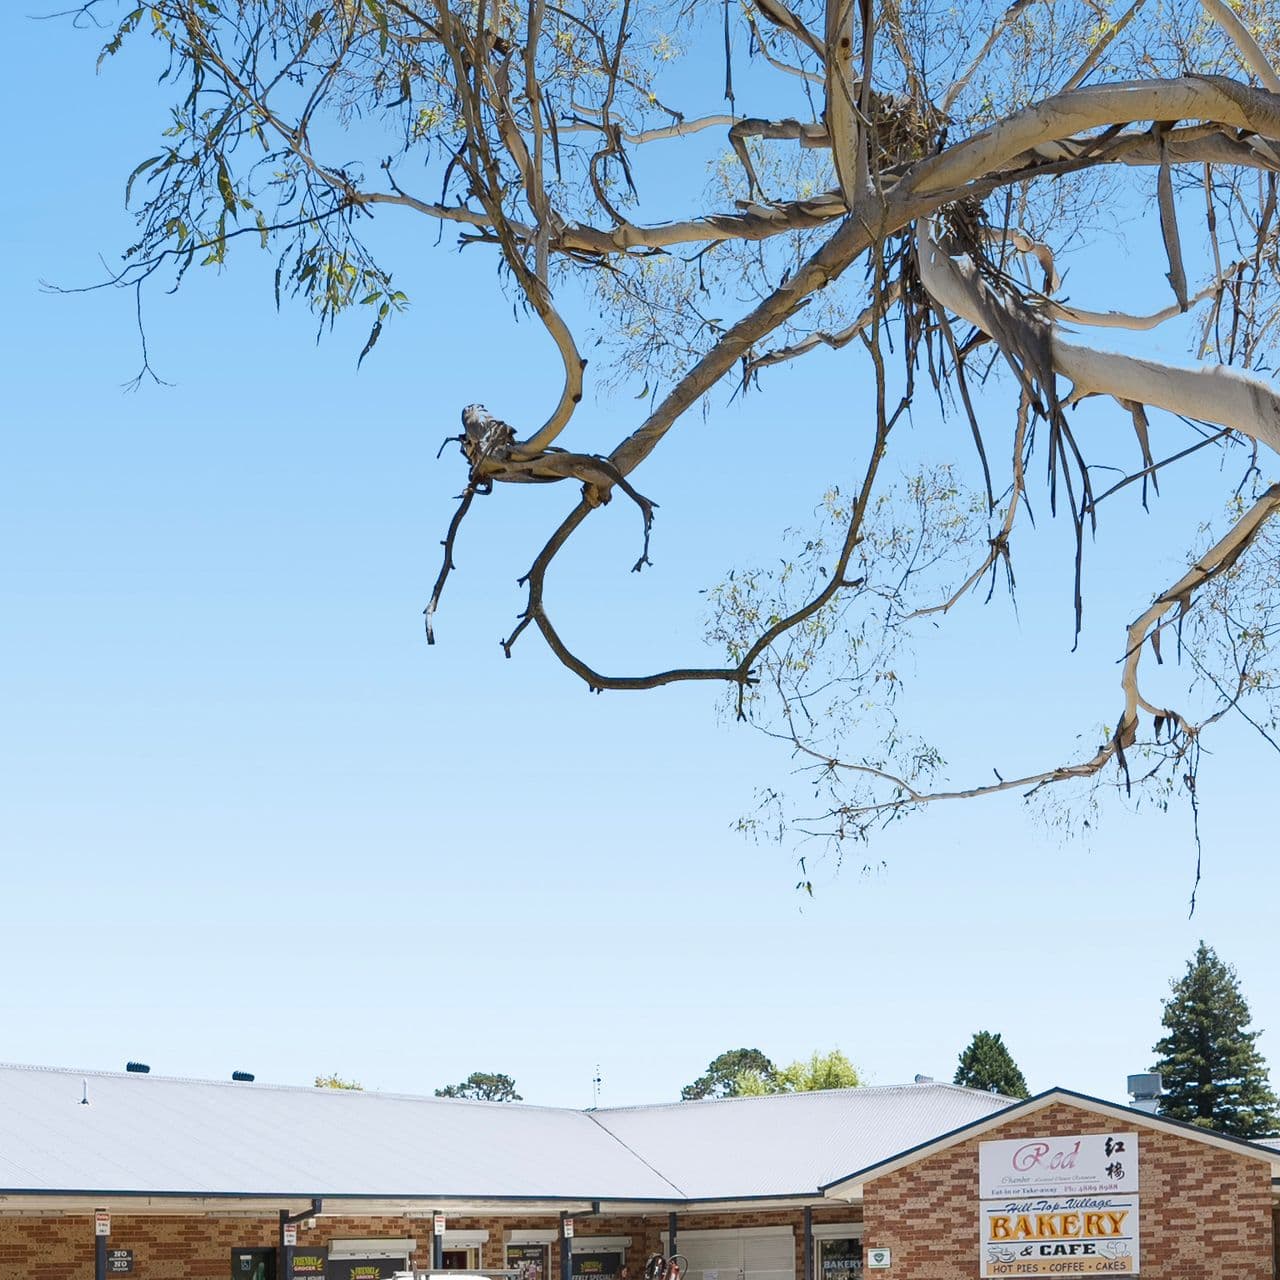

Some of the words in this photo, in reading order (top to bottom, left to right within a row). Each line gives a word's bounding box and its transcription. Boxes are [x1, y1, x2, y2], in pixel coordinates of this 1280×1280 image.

[1005, 1202, 1031, 1213] Hill
[1036, 1200, 1060, 1211] Top
[1065, 1199, 1112, 1210] Village
[989, 1210, 1129, 1241] BAKERY
[113, 1250, 128, 1258] NO
[1020, 1245, 1033, 1257] &
[1039, 1243, 1096, 1256] CAFE
[113, 1260, 128, 1268] NO
[823, 1260, 863, 1270] BAKERY
[993, 1264, 1014, 1273] HOT
[1017, 1263, 1038, 1273] PIES
[1049, 1261, 1085, 1272] COFFEE
[1095, 1260, 1126, 1271] CAKES
